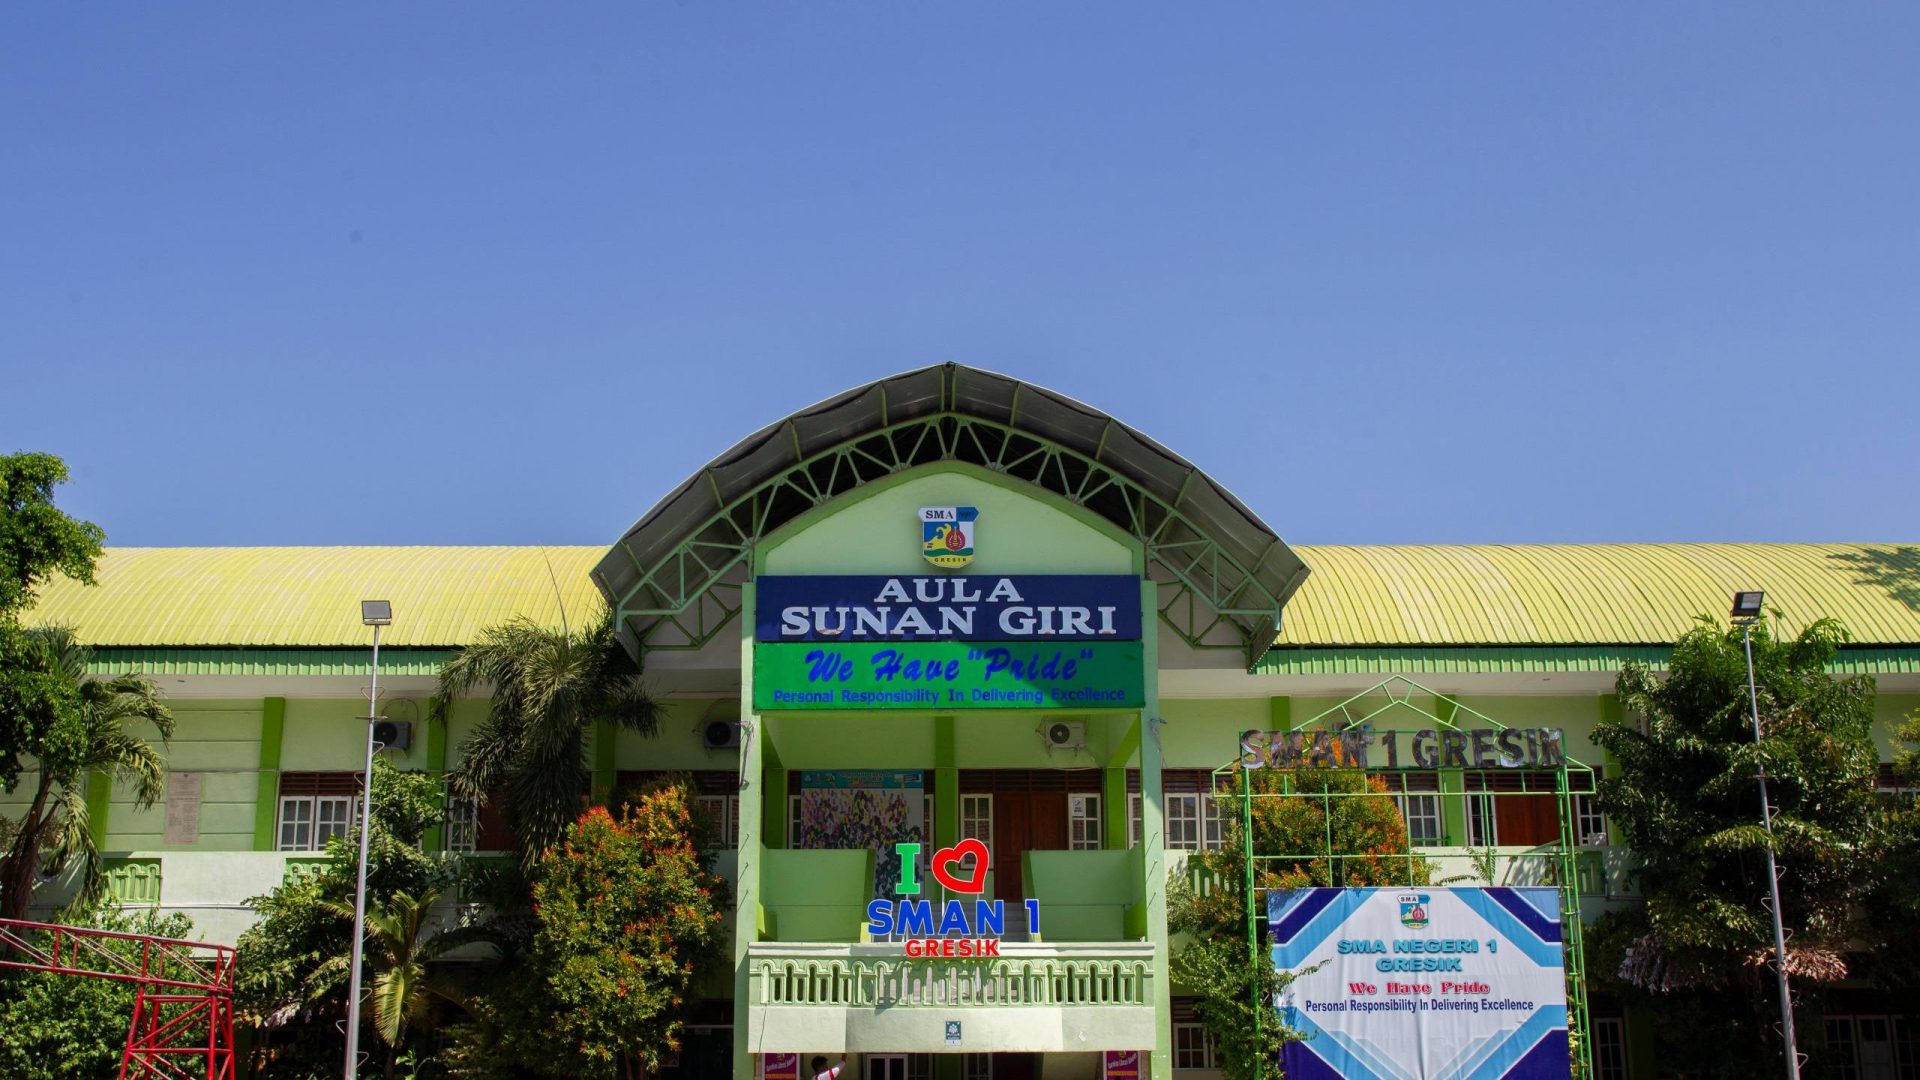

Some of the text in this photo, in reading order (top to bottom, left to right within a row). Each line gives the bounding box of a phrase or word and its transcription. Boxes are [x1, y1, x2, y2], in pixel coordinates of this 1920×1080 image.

[925, 510, 954, 519] SMA
[873, 578, 1025, 603] AULA
[781, 606, 1117, 636] SUNAN GIRI
[804, 649, 854, 683] We
[870, 649, 960, 683] Have
[773, 688, 1126, 705] Personal Responsibility In Delivering Excellence
[1241, 728, 1568, 769] SMAN 1 GRESIK
[895, 843, 921, 894] I
[867, 899, 1040, 935] SMAN 1
[905, 939, 1000, 958] GRESIK
[1337, 939, 1498, 954] SMA NEGERI 1
[1375, 958, 1462, 972] GRESIK
[1348, 981, 1491, 995] We Have Pride
[1305, 999, 1534, 1014] Personal Responsibility In Delivering Excellence
